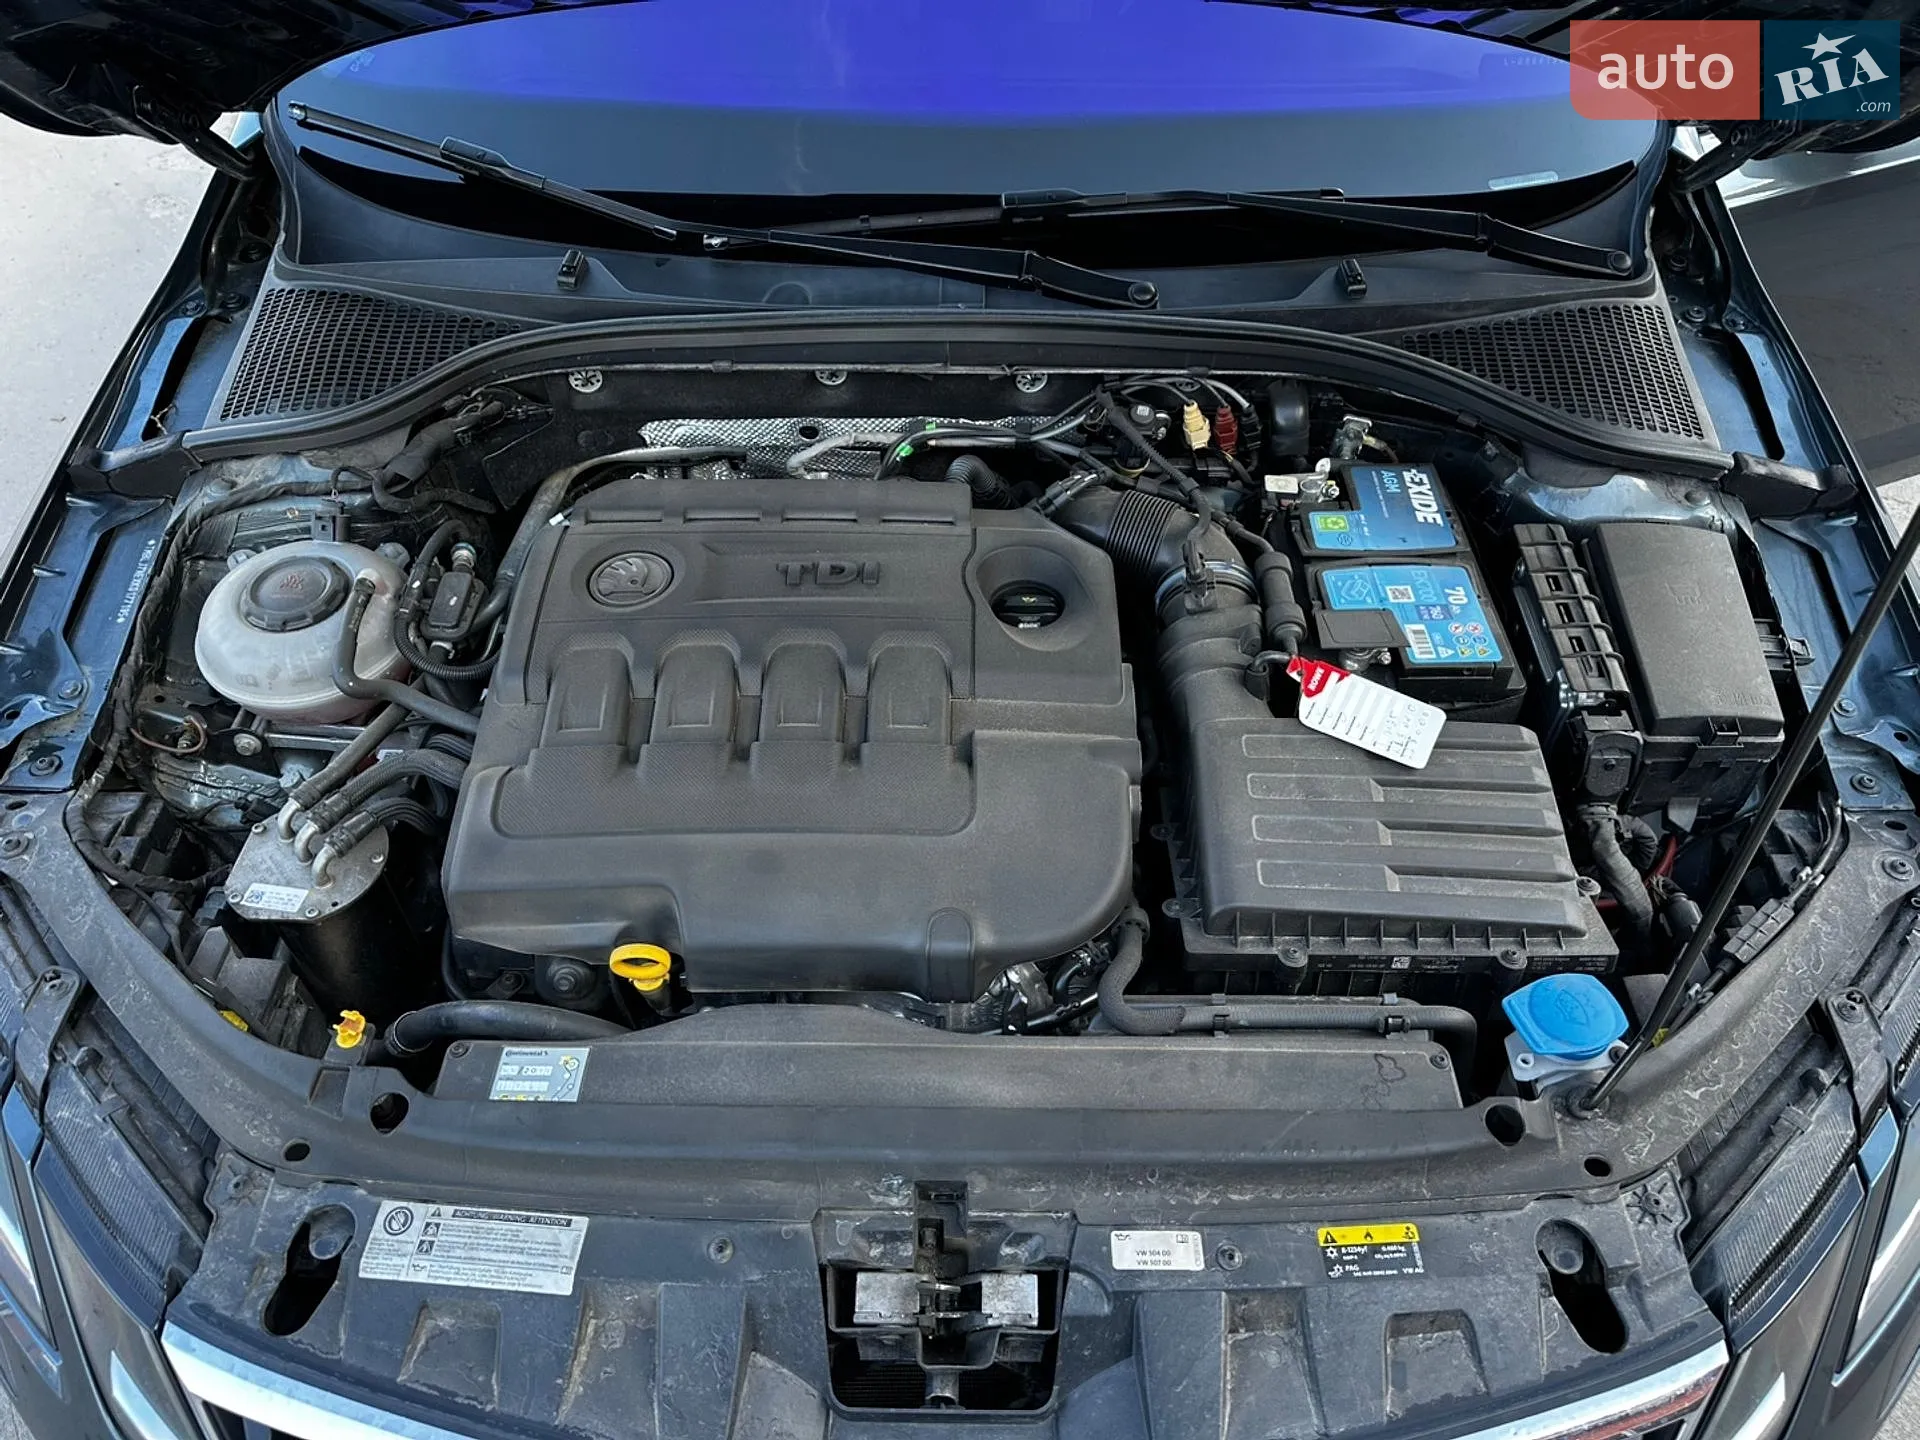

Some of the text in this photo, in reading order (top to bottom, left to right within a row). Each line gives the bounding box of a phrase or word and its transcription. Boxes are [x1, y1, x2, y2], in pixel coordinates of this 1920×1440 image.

[1381, 470, 1401, 493] AGM
[1402, 468, 1444, 527] EXIDE
[776, 561, 880, 586] TDI
[1444, 586, 1468, 605] 70
